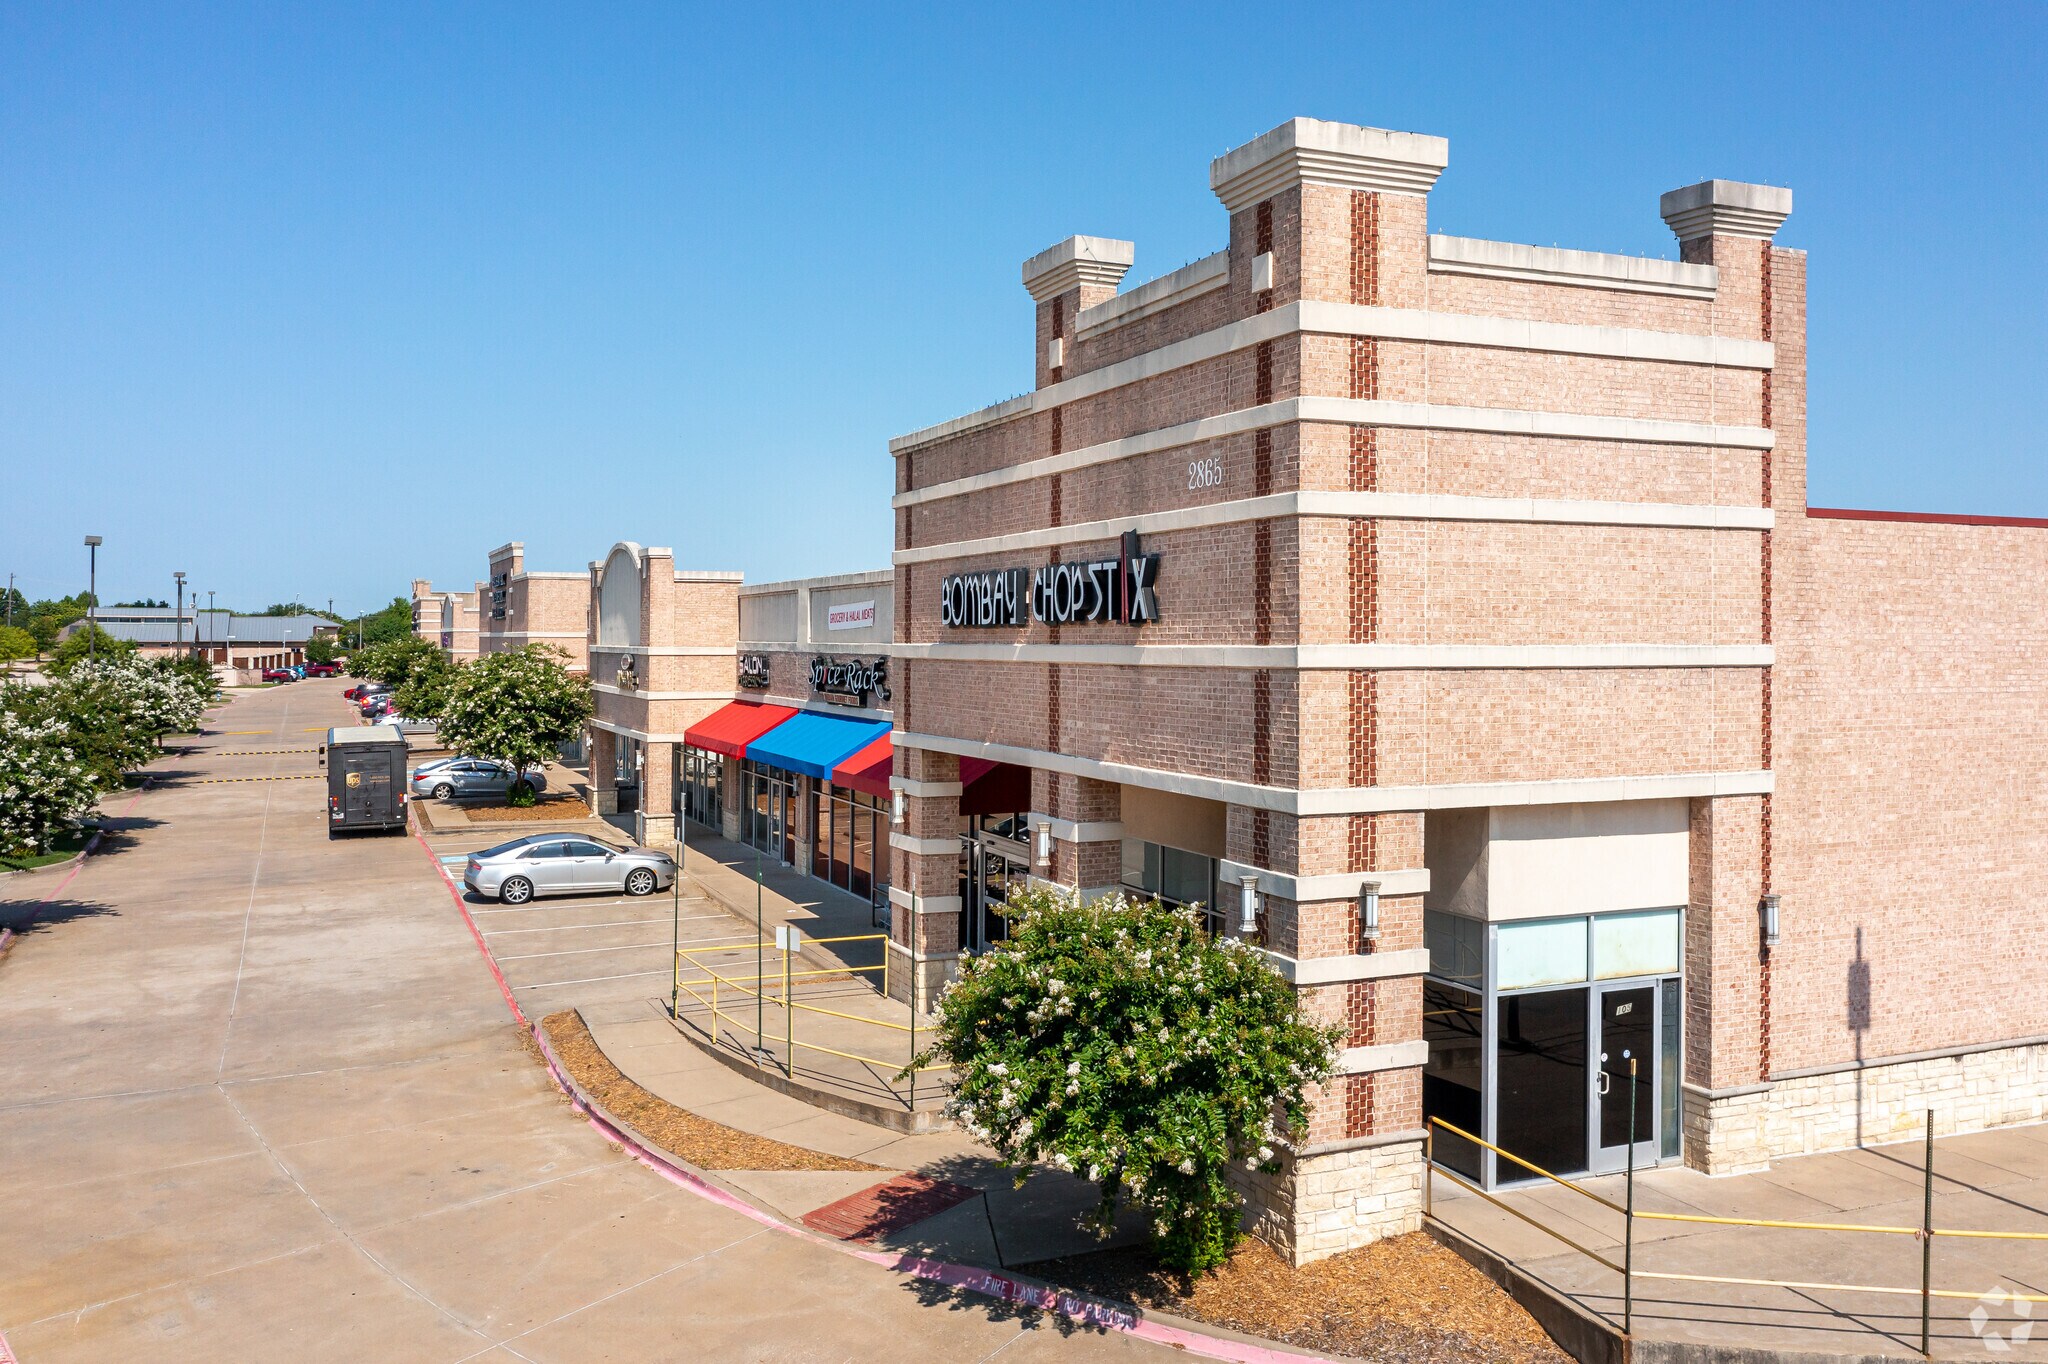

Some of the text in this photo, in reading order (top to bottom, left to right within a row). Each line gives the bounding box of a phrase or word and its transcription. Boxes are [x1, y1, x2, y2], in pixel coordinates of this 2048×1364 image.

[1188, 457, 1222, 490] 2865
[941, 532, 1148, 626] BOMBAY CHOPSTIX
[829, 612, 845, 624] GROCERY
[850, 610, 861, 621] HALAL
[862, 607, 874, 620] MEATS
[739, 656, 763, 675] SALON
[808, 658, 884, 699] Spice Rack
[347, 777, 360, 786] ups
[981, 1276, 1135, 1330] FIRE LANE NO PARKING
